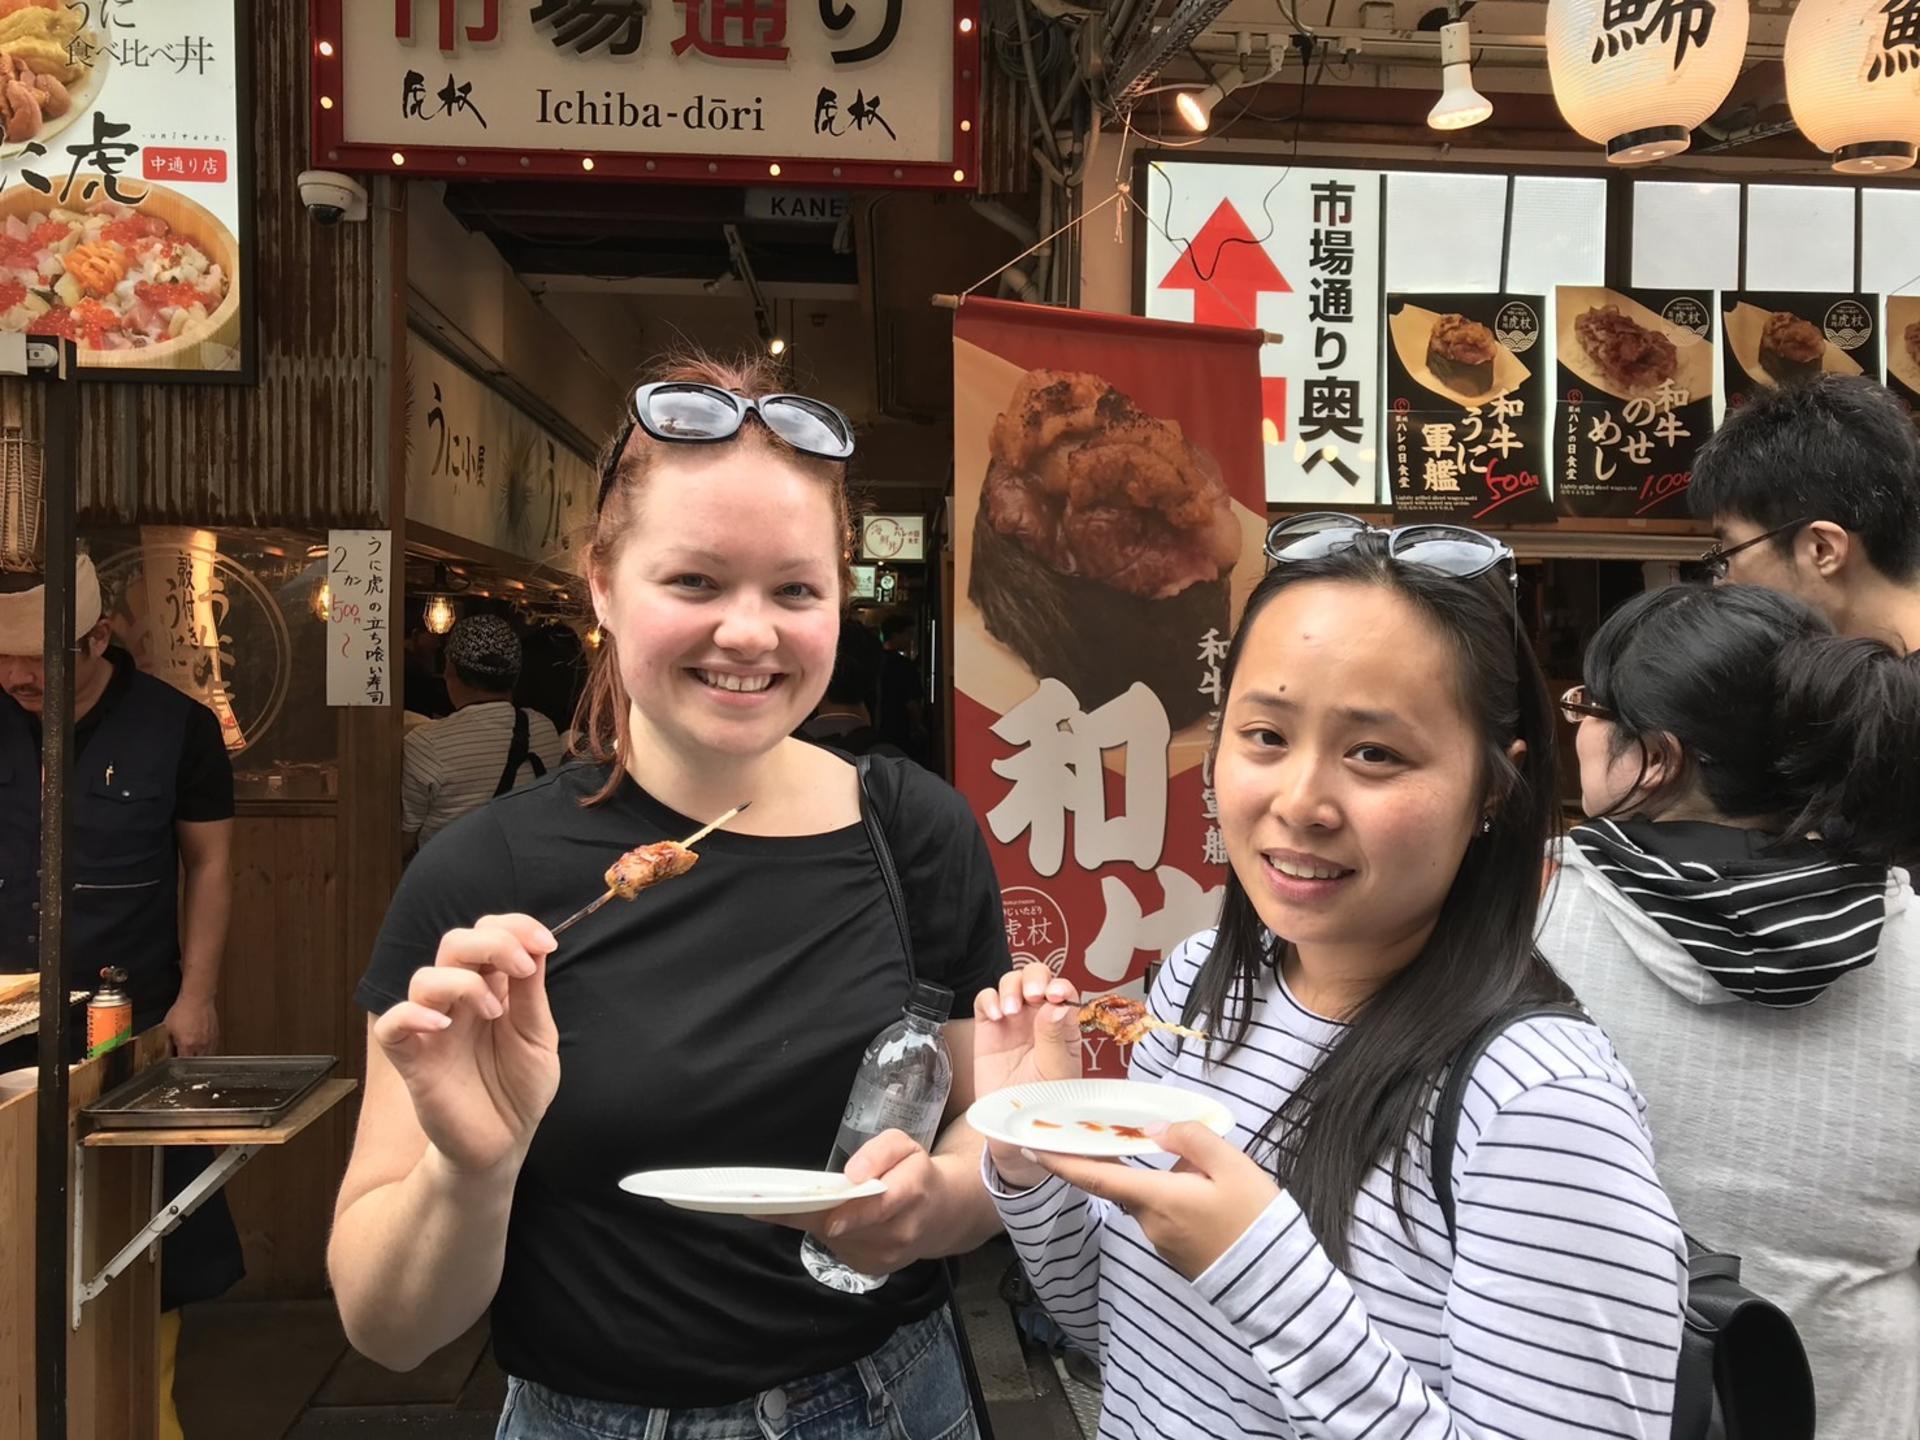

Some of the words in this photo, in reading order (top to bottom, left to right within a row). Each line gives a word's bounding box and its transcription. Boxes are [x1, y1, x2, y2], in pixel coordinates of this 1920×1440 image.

[65, 35, 215, 75] 食べ比べ丼
[535, 88, 766, 131] Ichiba-dōri
[151, 155, 218, 175] 中通り店
[1299, 179, 1363, 487] 市場通り奥へ
[1457, 407, 1488, 474] うに
[1488, 388, 1524, 459] 和牛
[1588, 410, 1622, 481] めし
[1620, 397, 1655, 464] のせ
[1654, 378, 1691, 448] 和牛
[1421, 423, 1460, 492] 軍艦
